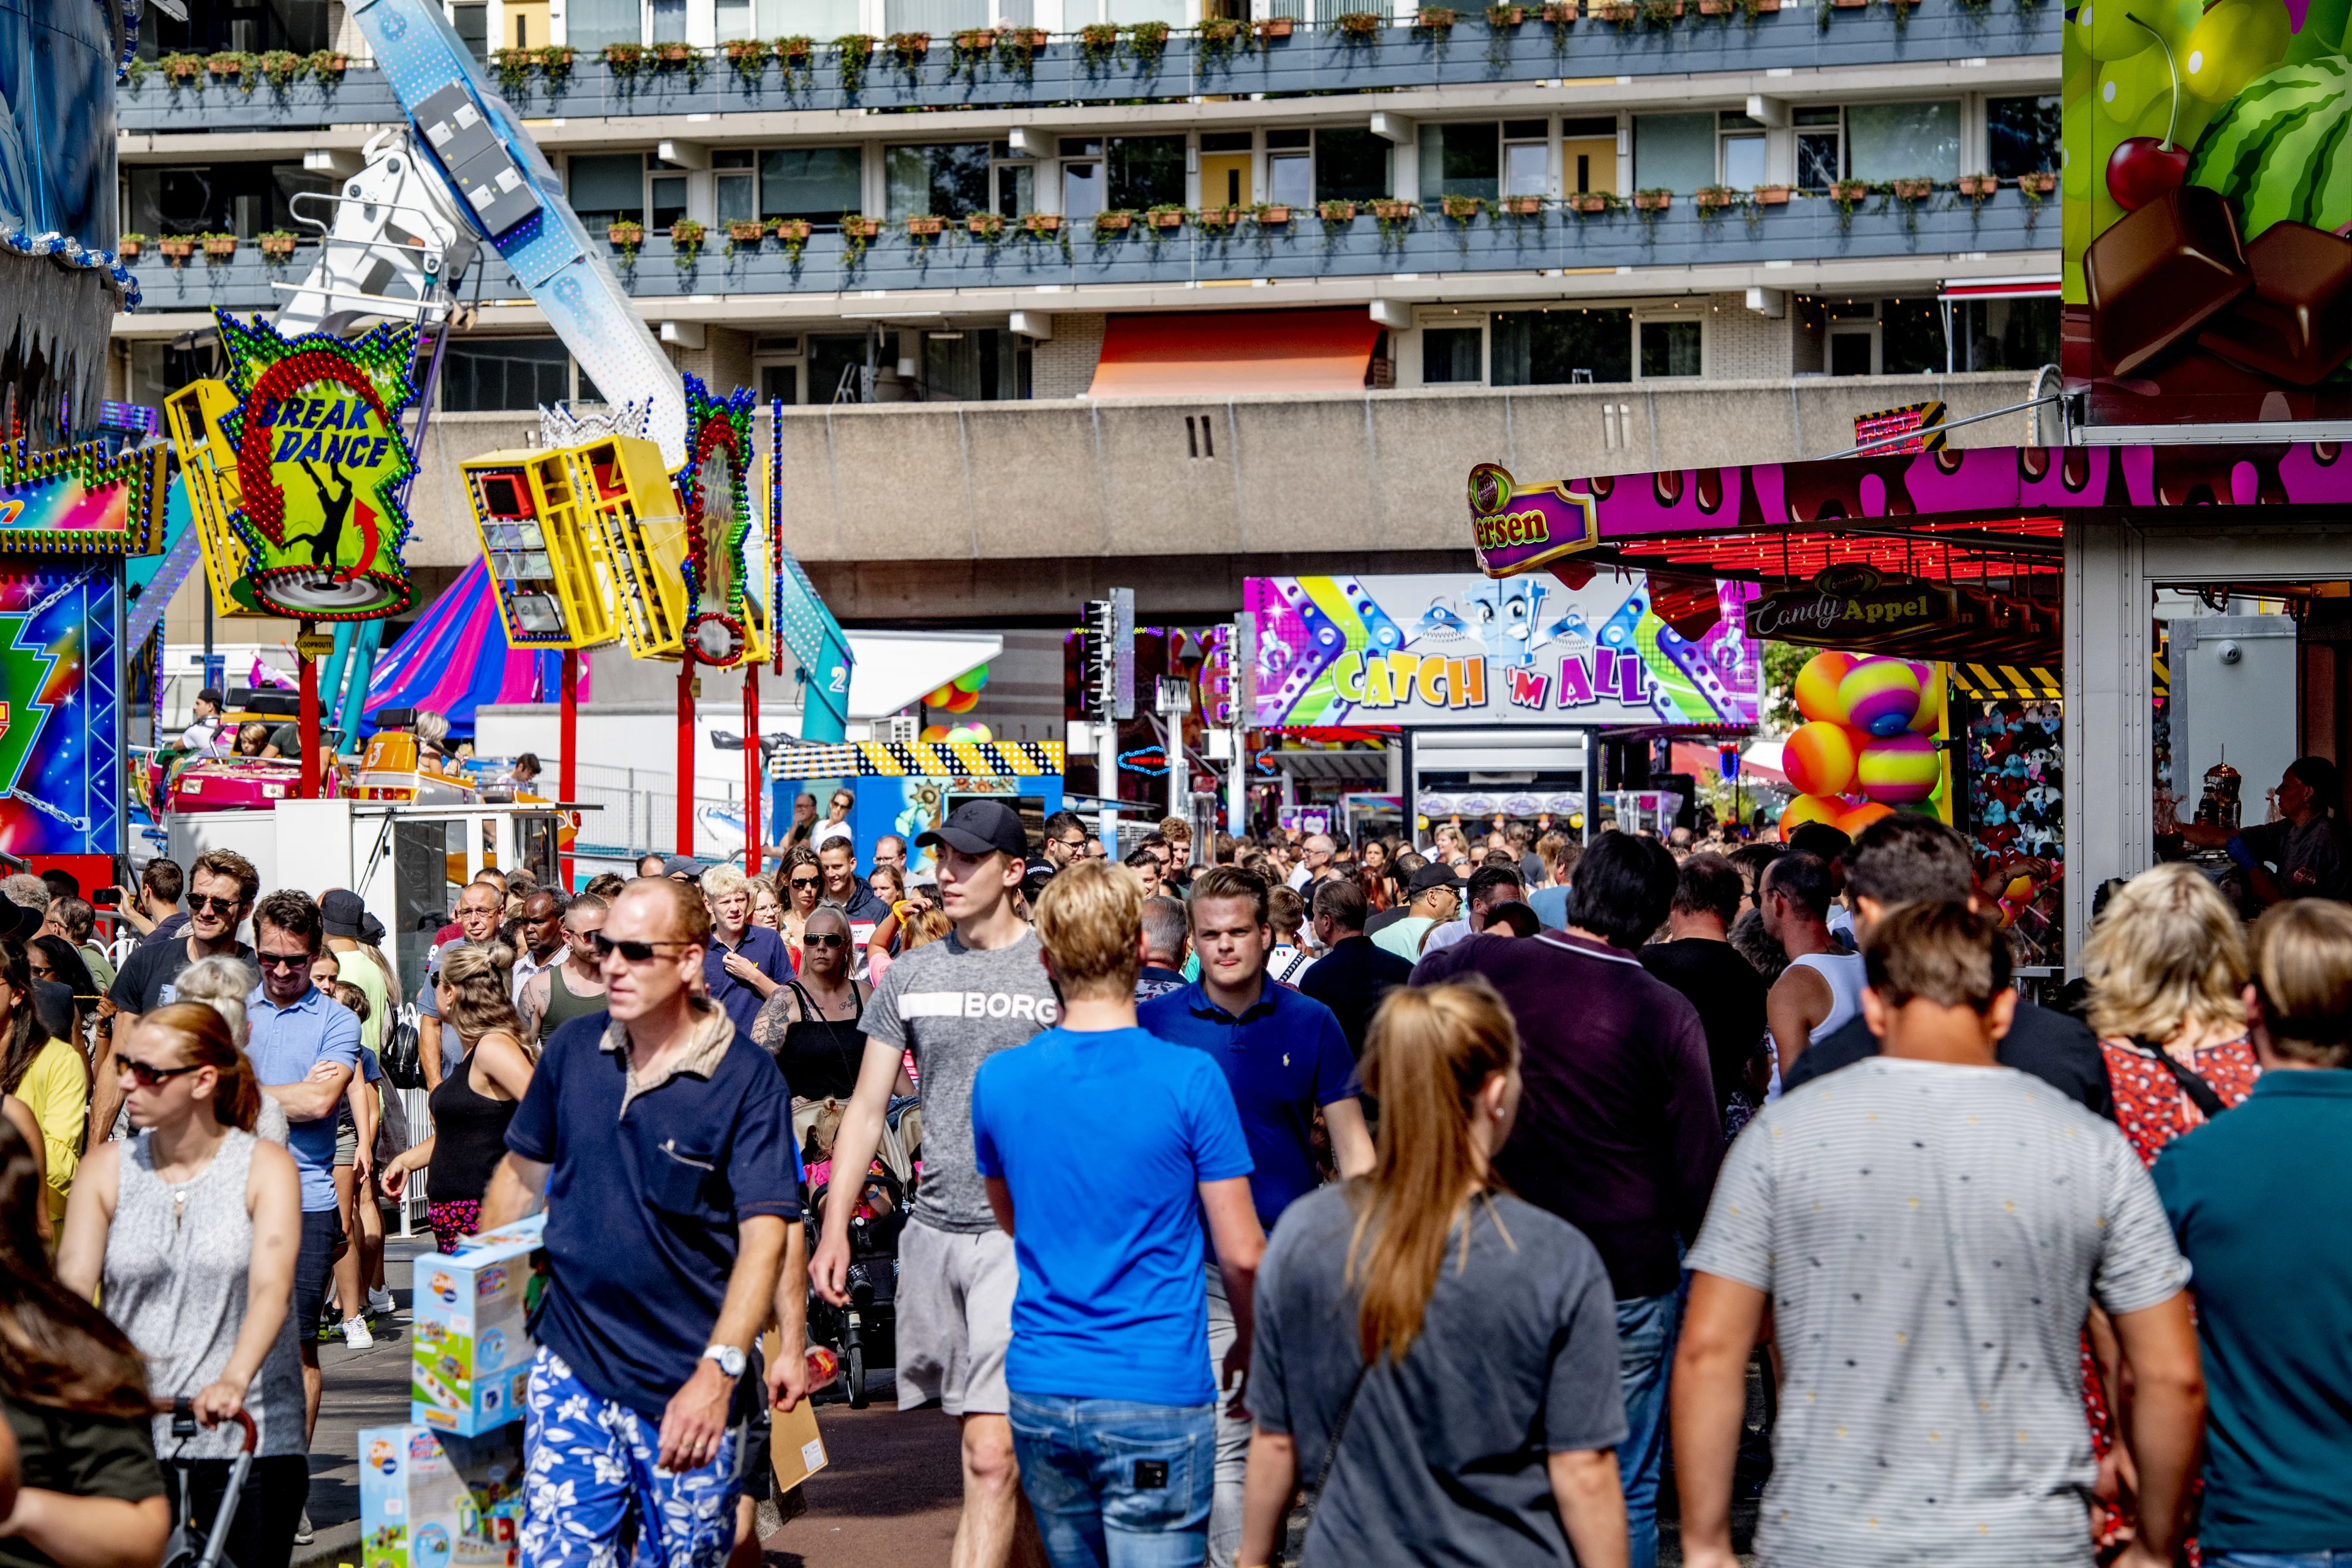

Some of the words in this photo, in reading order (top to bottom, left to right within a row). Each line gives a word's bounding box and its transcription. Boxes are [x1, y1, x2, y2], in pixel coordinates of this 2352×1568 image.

[255, 397, 373, 431] BREAK
[273, 431, 388, 469] DANCE
[1475, 510, 1548, 549] ersen
[1744, 594, 1841, 635] Candy
[1842, 595, 1928, 623] Appel
[829, 666, 846, 693] 2
[1332, 649, 1486, 709] CATCH
[1506, 665, 1548, 709] 'M
[1556, 645, 1651, 707] ALL
[368, 742, 385, 767] 3
[964, 992, 1057, 1023] BORG
